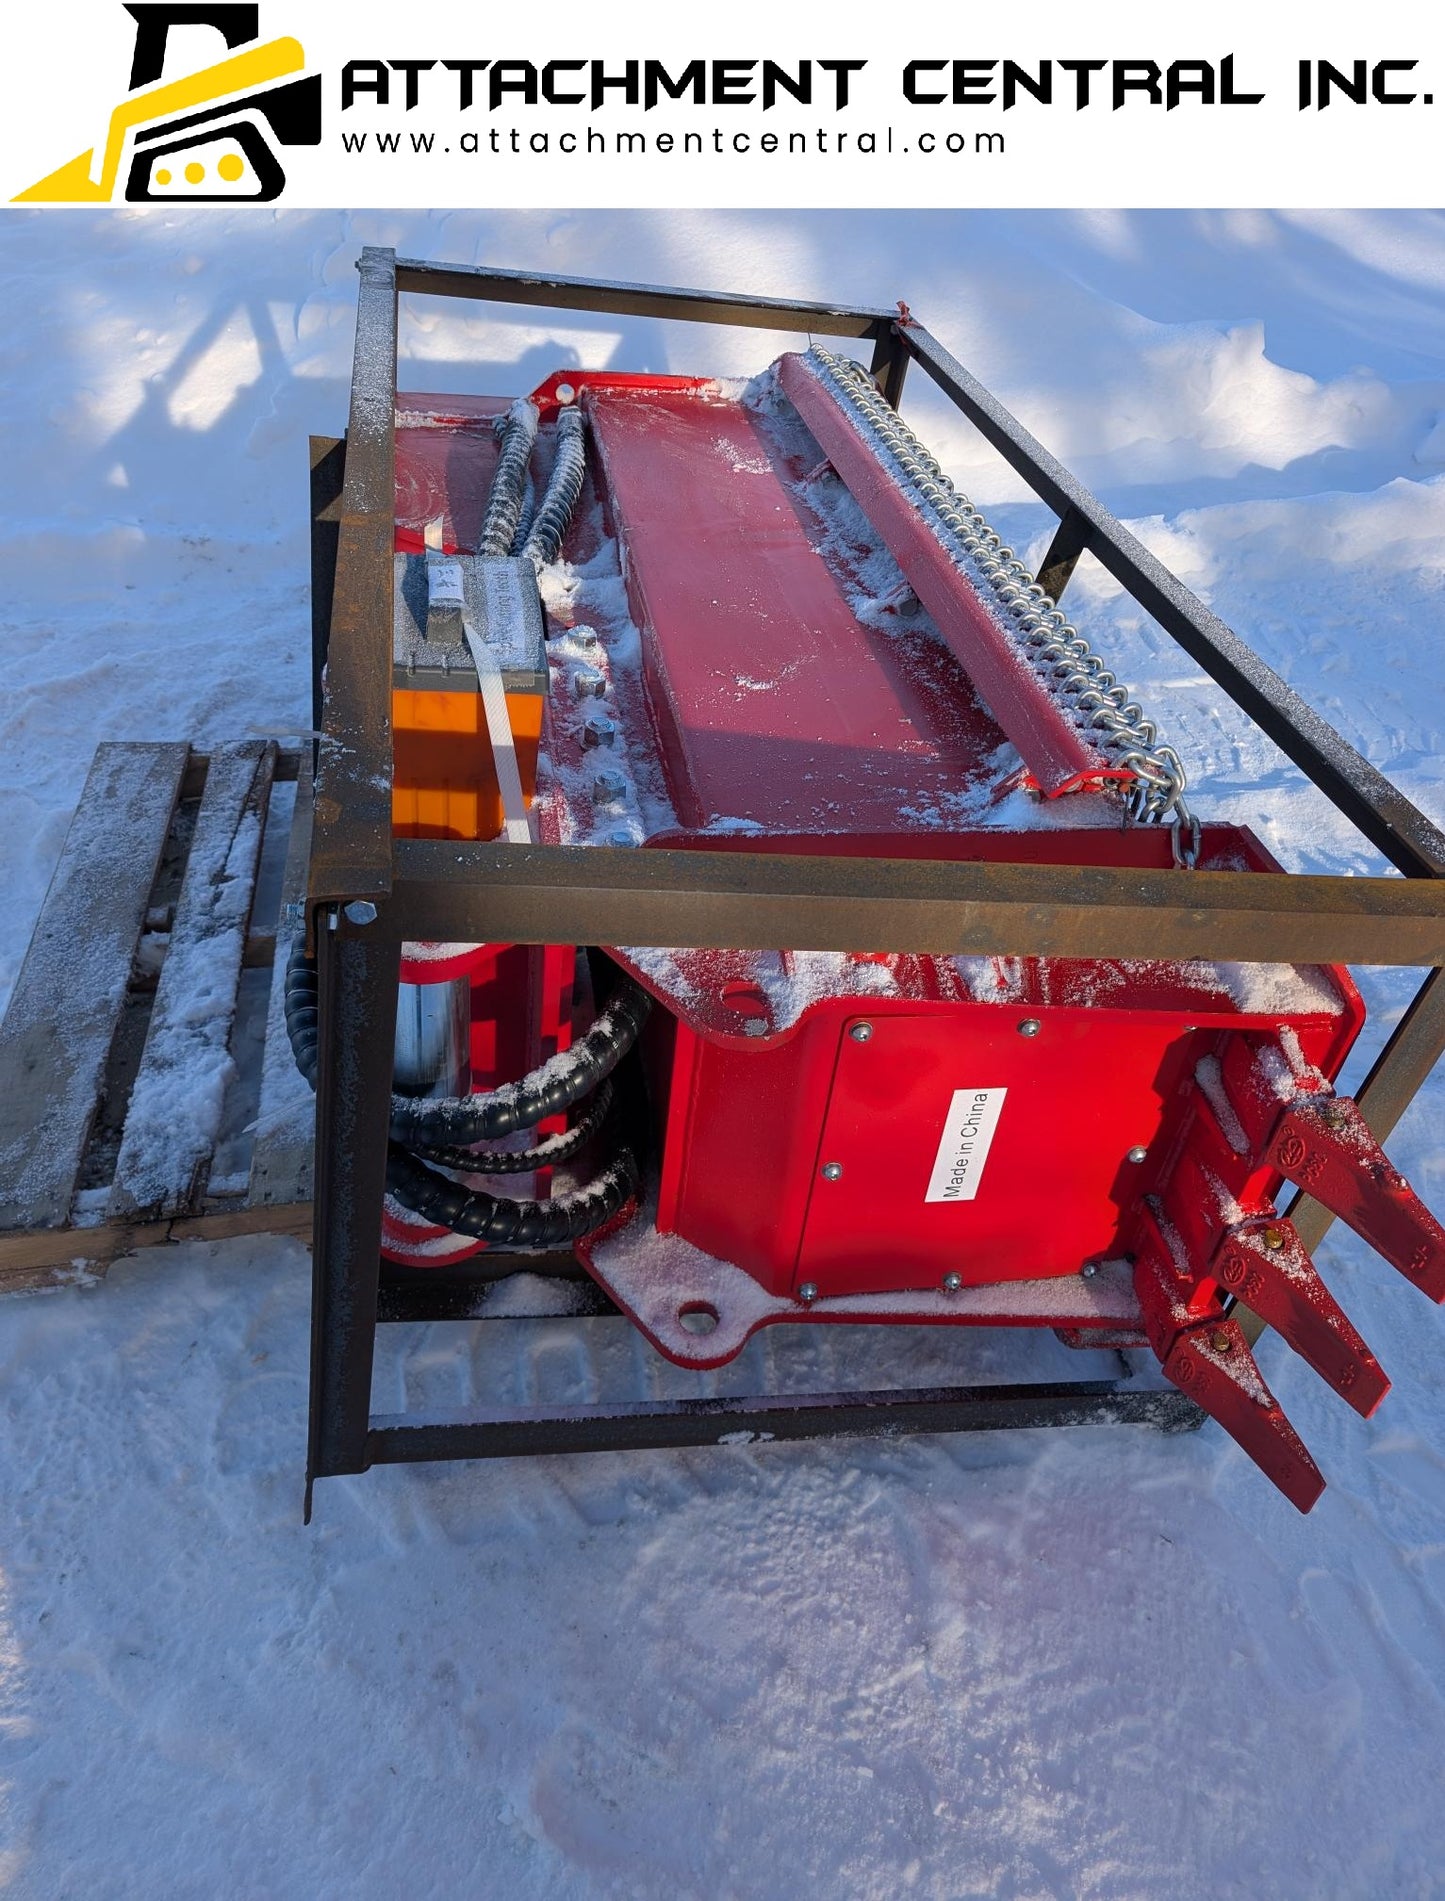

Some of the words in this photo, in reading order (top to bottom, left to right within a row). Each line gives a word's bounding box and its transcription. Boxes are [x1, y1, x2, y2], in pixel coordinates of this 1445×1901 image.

[960, 1093, 988, 1138] China
[955, 1142, 974, 1155] in
[943, 1158, 969, 1198] Made
